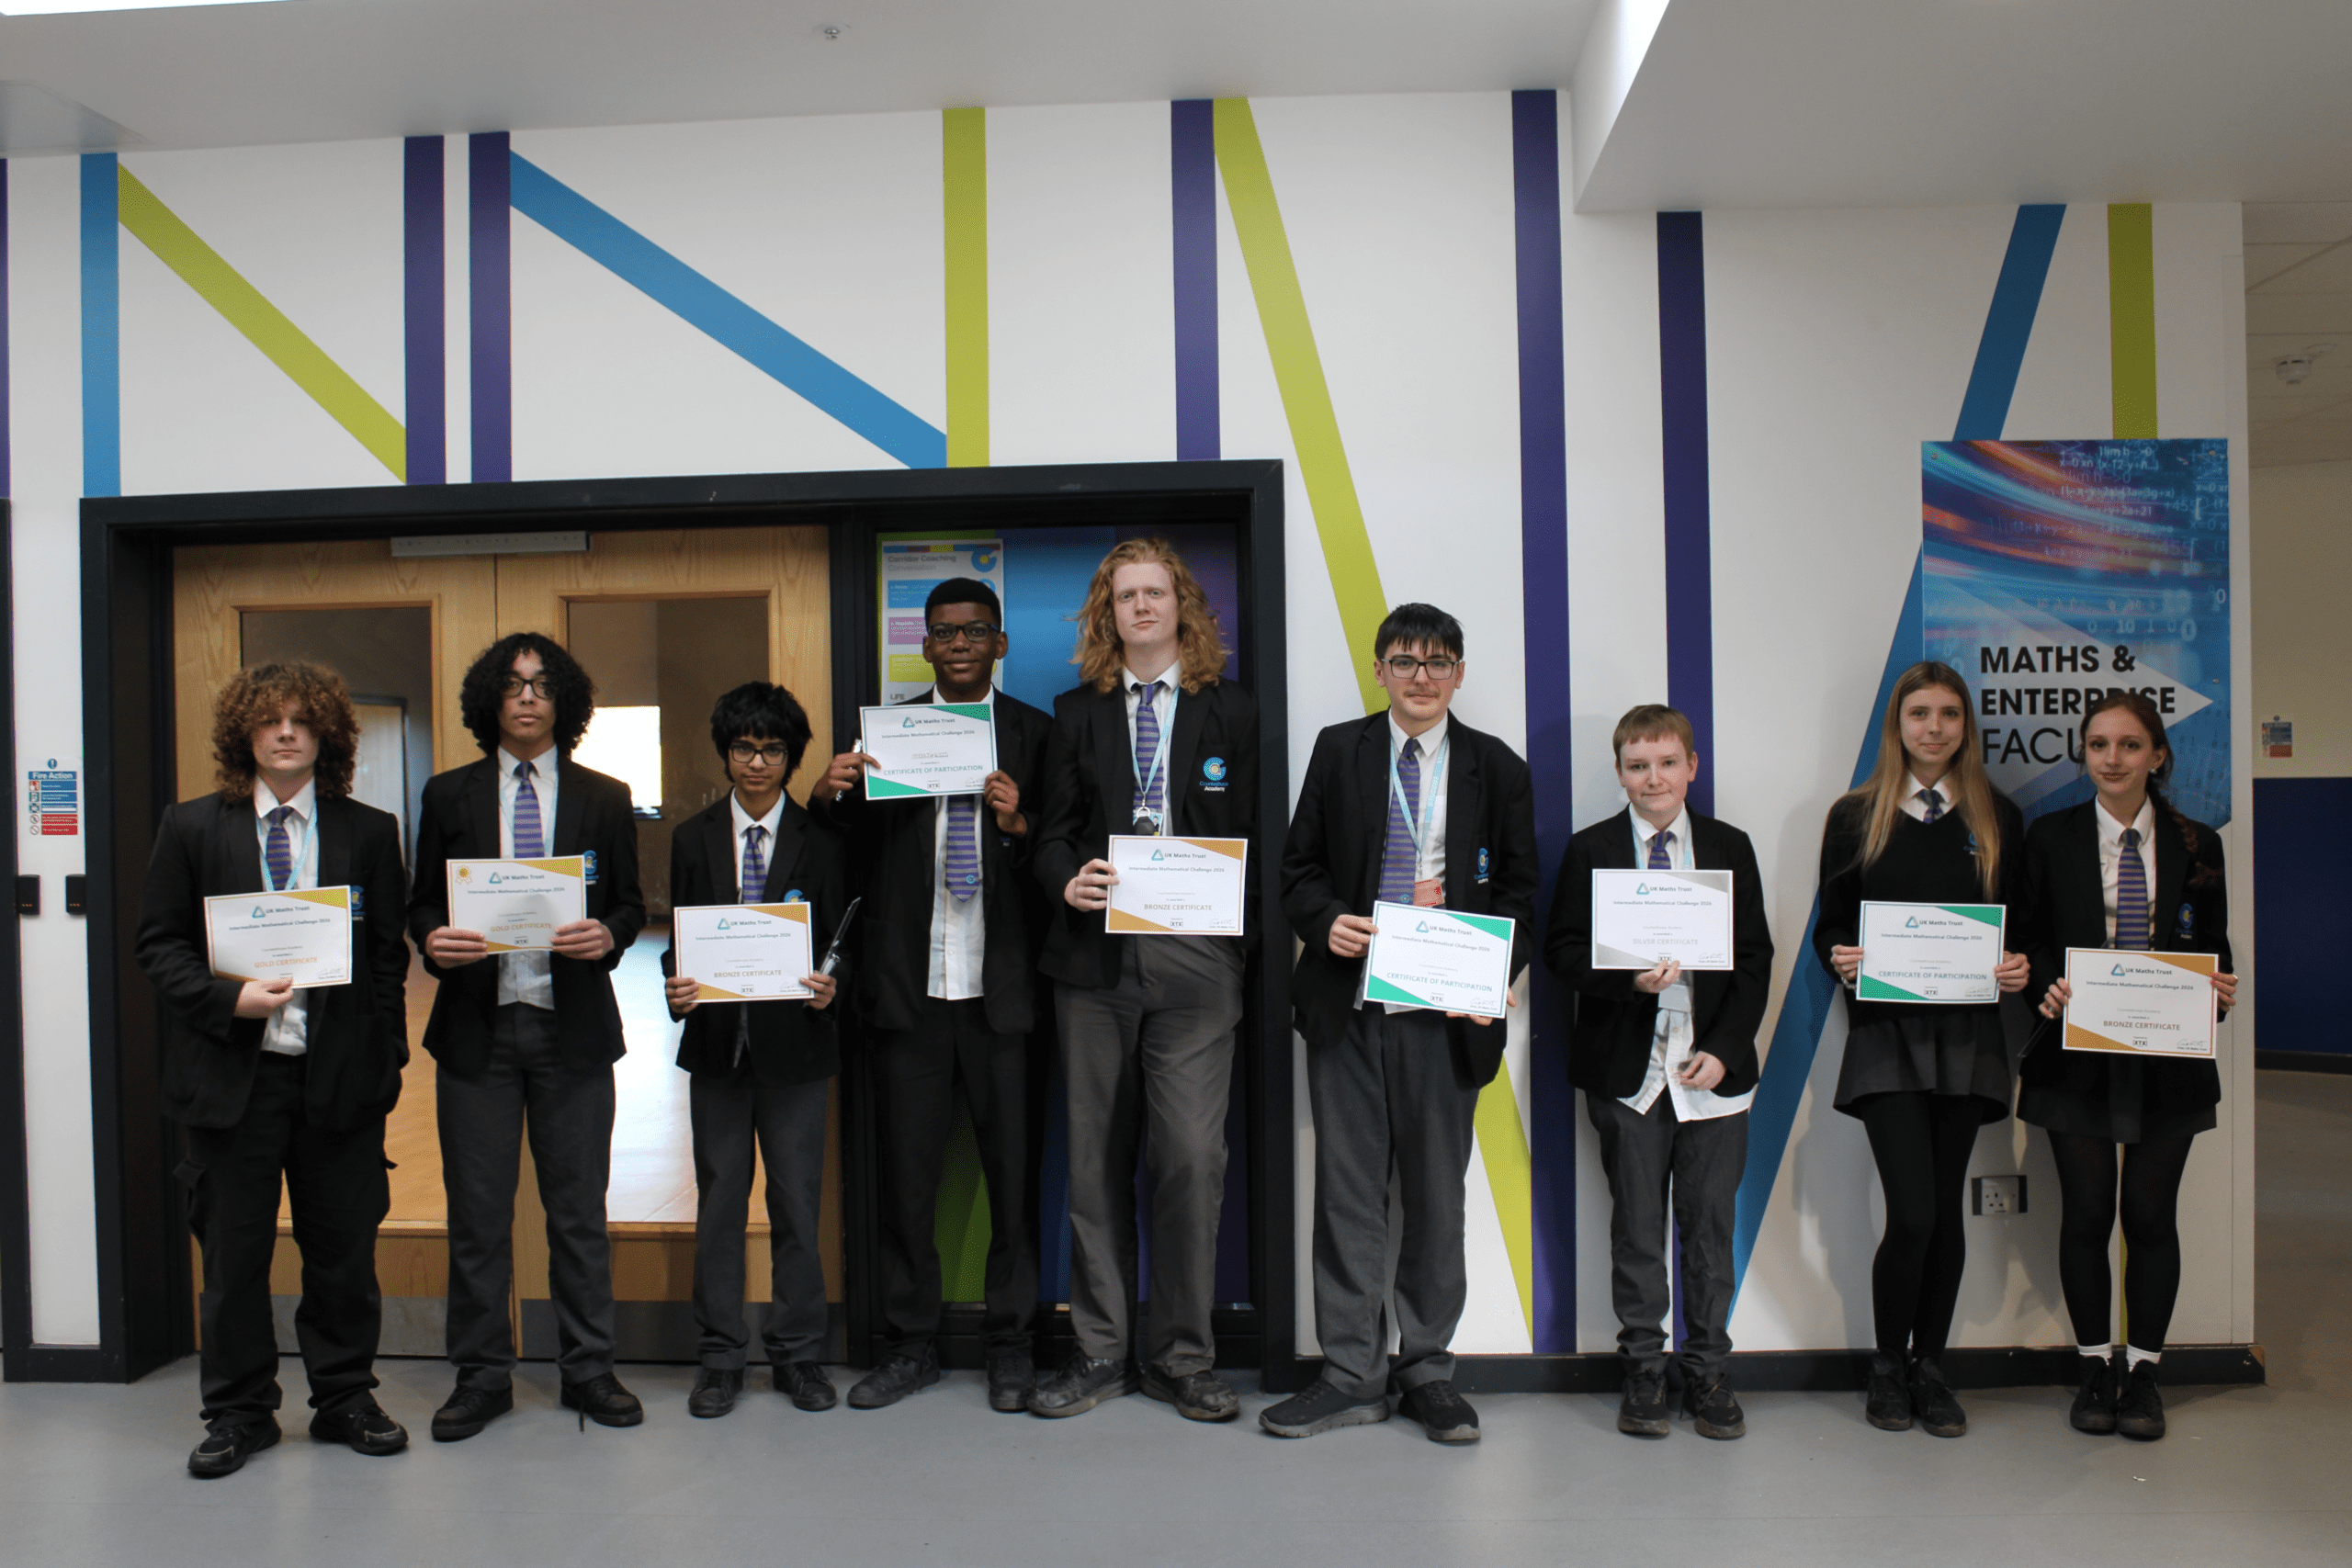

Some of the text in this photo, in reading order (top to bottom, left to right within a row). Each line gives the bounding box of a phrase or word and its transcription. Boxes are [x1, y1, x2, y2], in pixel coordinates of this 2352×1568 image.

[1981, 646, 2136, 673] MATHS &
[1981, 687, 2175, 715] ENTERPSE
[1455, 942, 1477, 951] Challenge
[1387, 973, 1429, 983] CERTIFICATE
[1442, 980, 1492, 991] PARTICIPATION
[2135, 1022, 2180, 1031] CERTIFICATE
